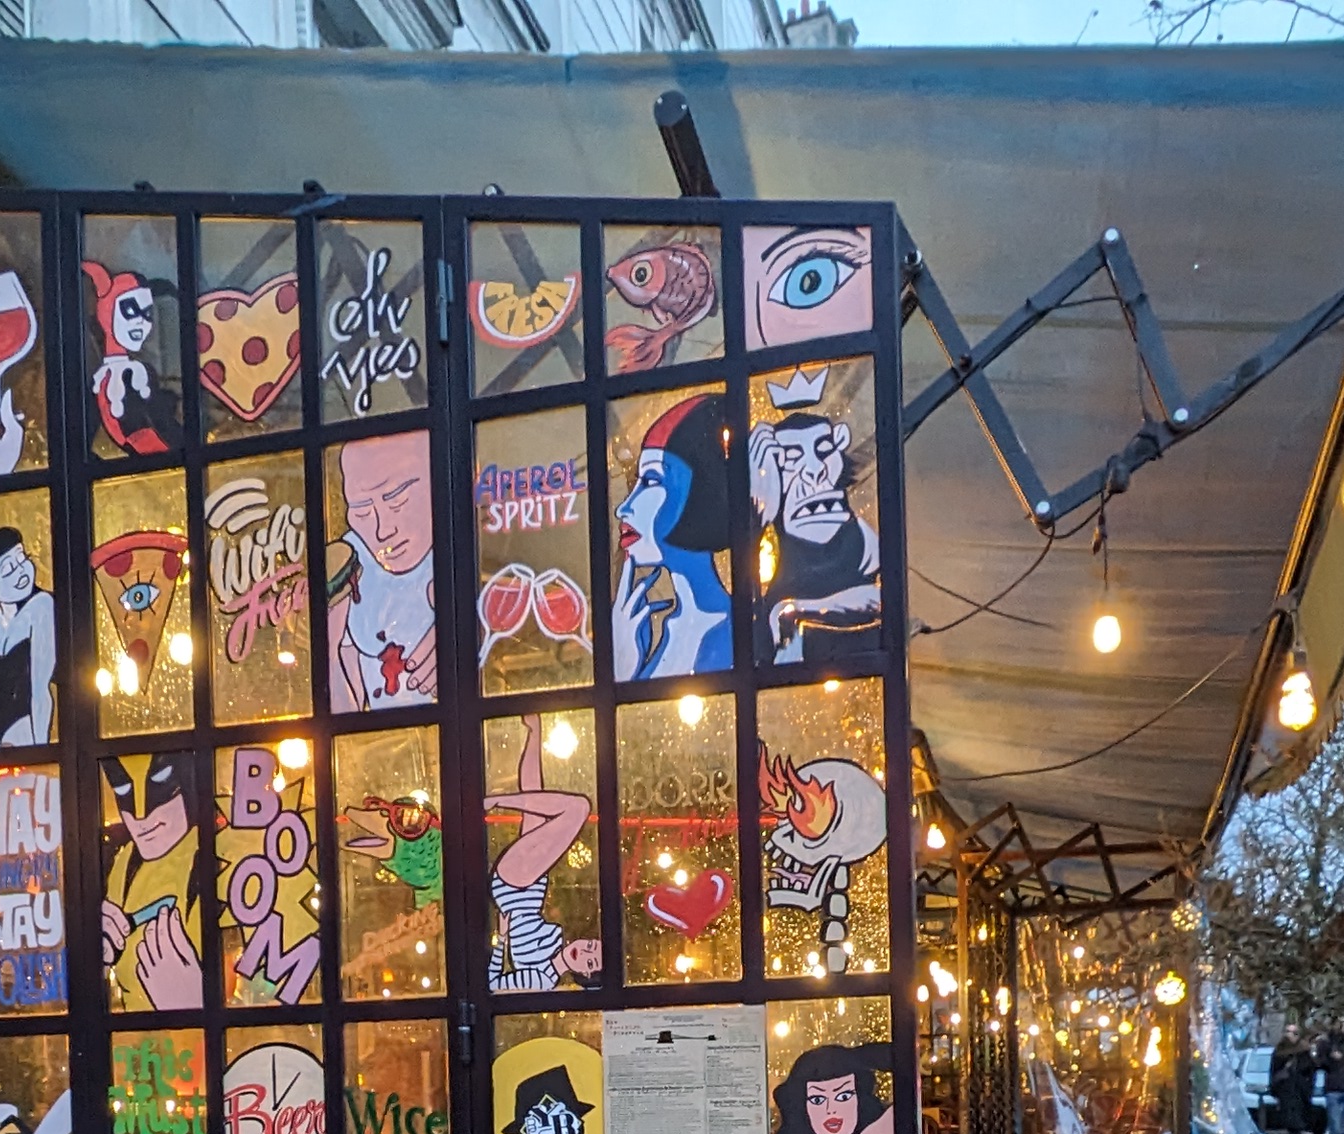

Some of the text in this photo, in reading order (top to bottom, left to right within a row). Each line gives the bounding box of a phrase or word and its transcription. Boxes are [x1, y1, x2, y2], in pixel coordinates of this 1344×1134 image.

[475, 457, 587, 501] APEROL
[227, 747, 321, 1005] BOOM
[114, 1037, 194, 1098] This
